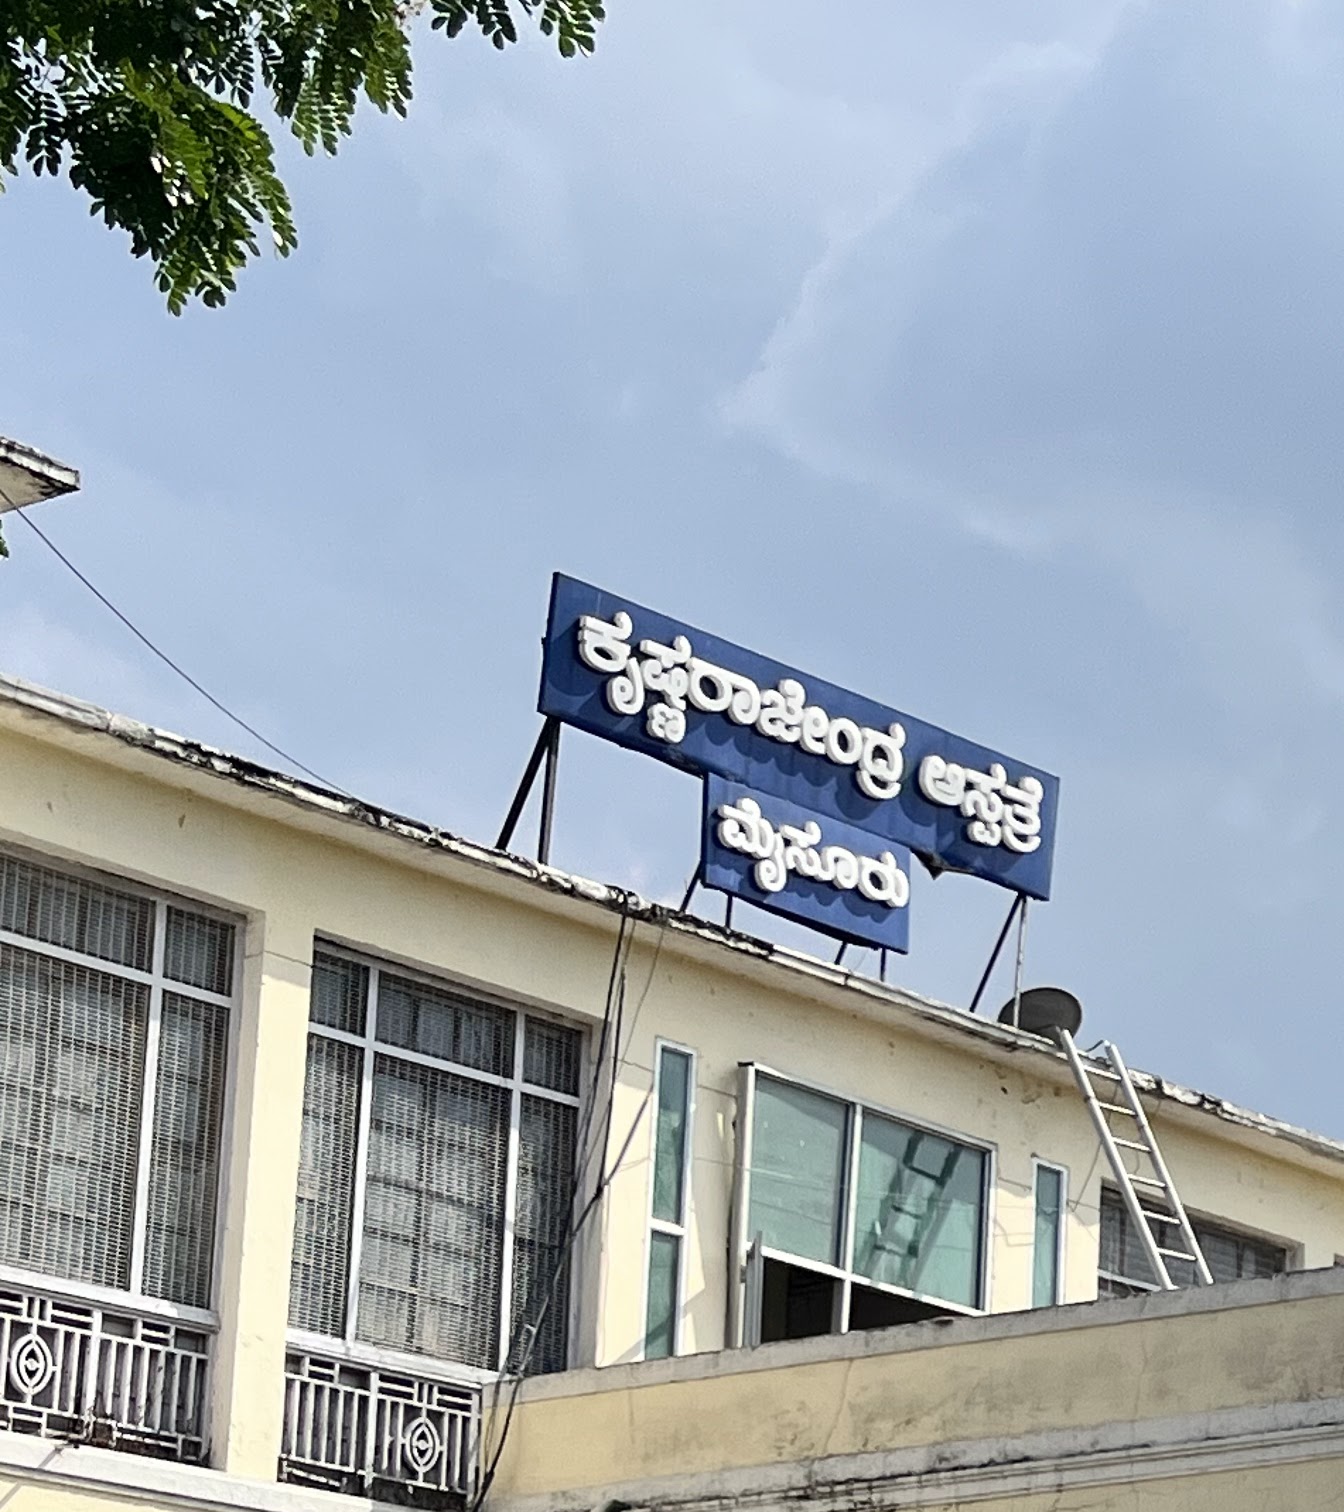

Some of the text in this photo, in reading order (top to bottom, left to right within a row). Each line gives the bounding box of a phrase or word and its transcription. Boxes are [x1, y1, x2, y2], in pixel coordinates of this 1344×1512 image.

[577, 610, 1044, 854] ಕೃಷ್ಣರಾಜೇಂದ್ರ ಆಸ್ಪತ್ರೆ
[717, 796, 911, 909] ಮೈಸೂರು
